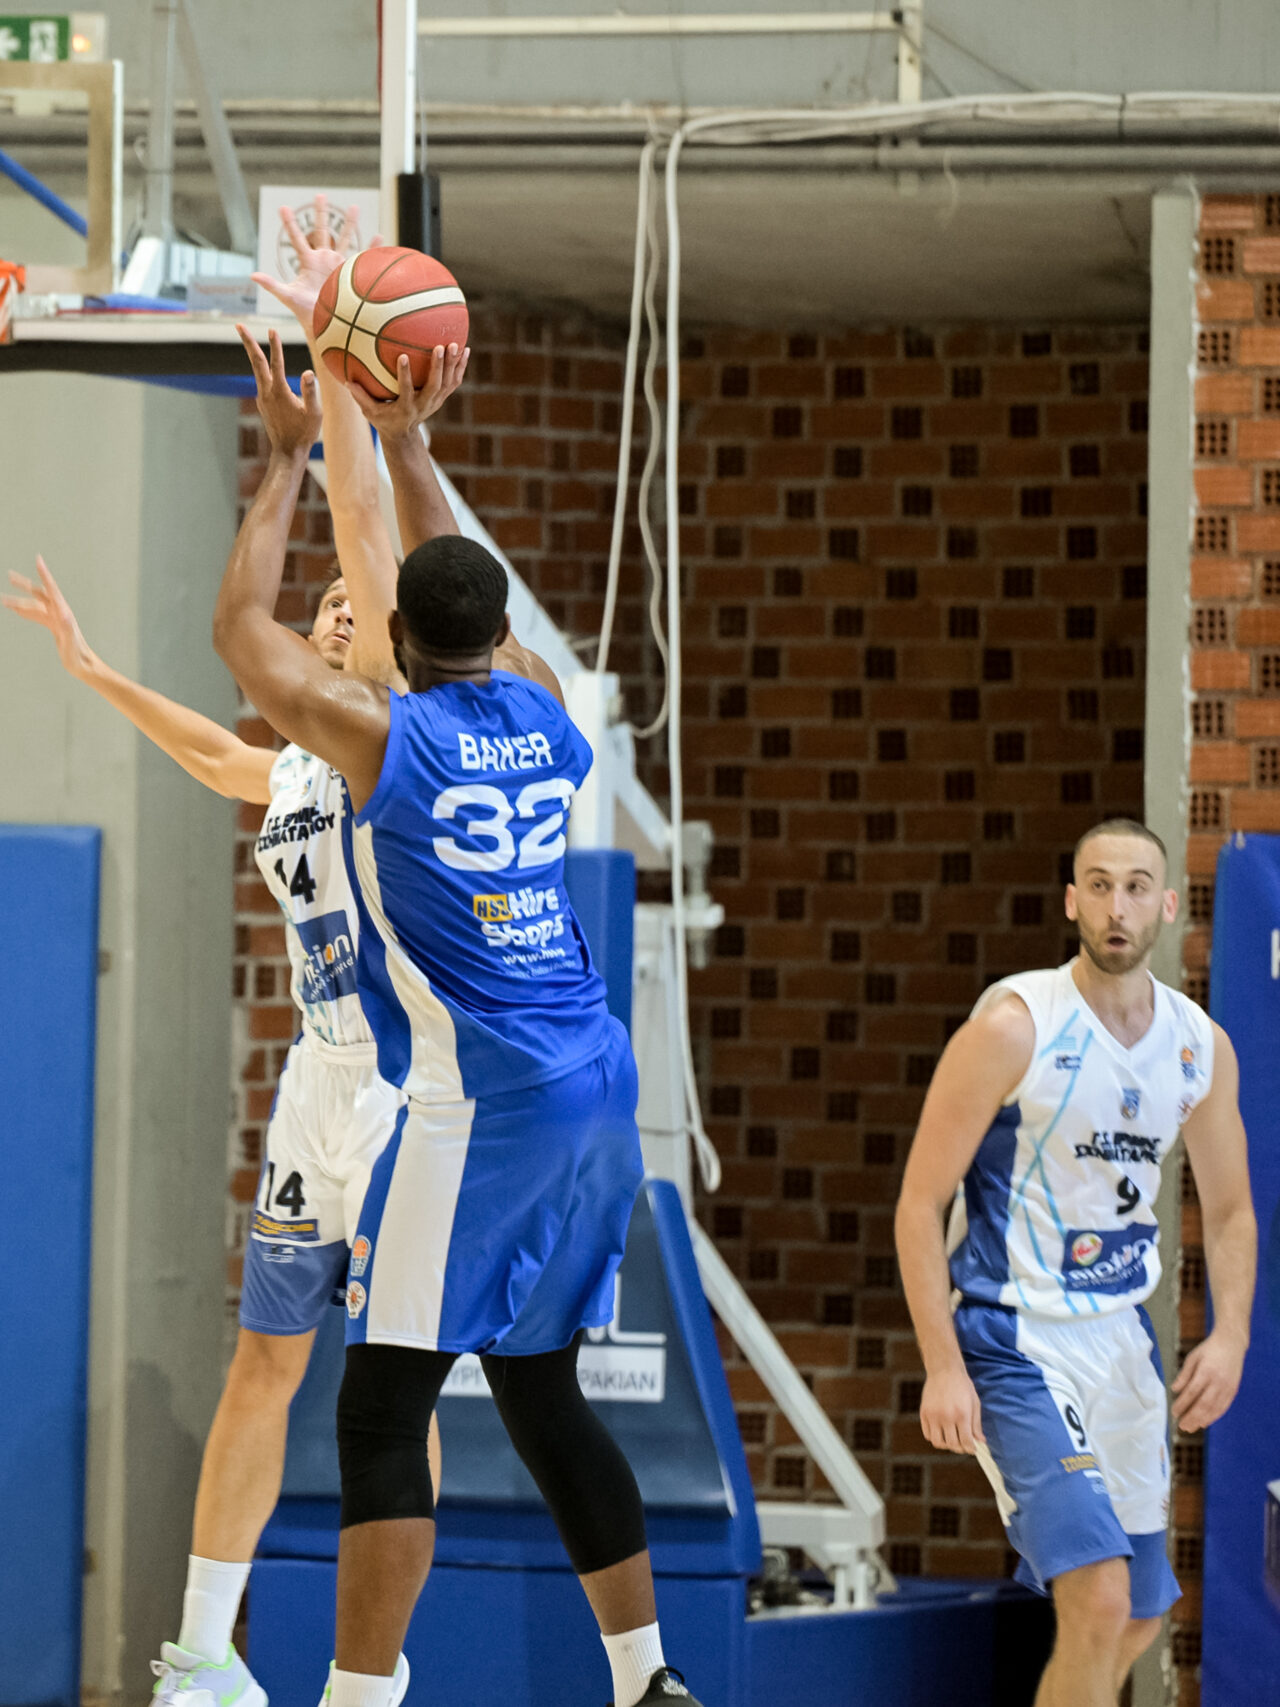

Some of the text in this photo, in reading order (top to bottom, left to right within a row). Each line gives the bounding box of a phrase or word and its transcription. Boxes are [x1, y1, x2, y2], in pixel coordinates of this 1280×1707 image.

[431, 777, 576, 872] 32
[273, 852, 317, 907] 14
[507, 886, 560, 921] Hire
[264, 1160, 307, 1218] 14
[1116, 1175, 1141, 1216] 9
[1065, 1403, 1087, 1448] 9
